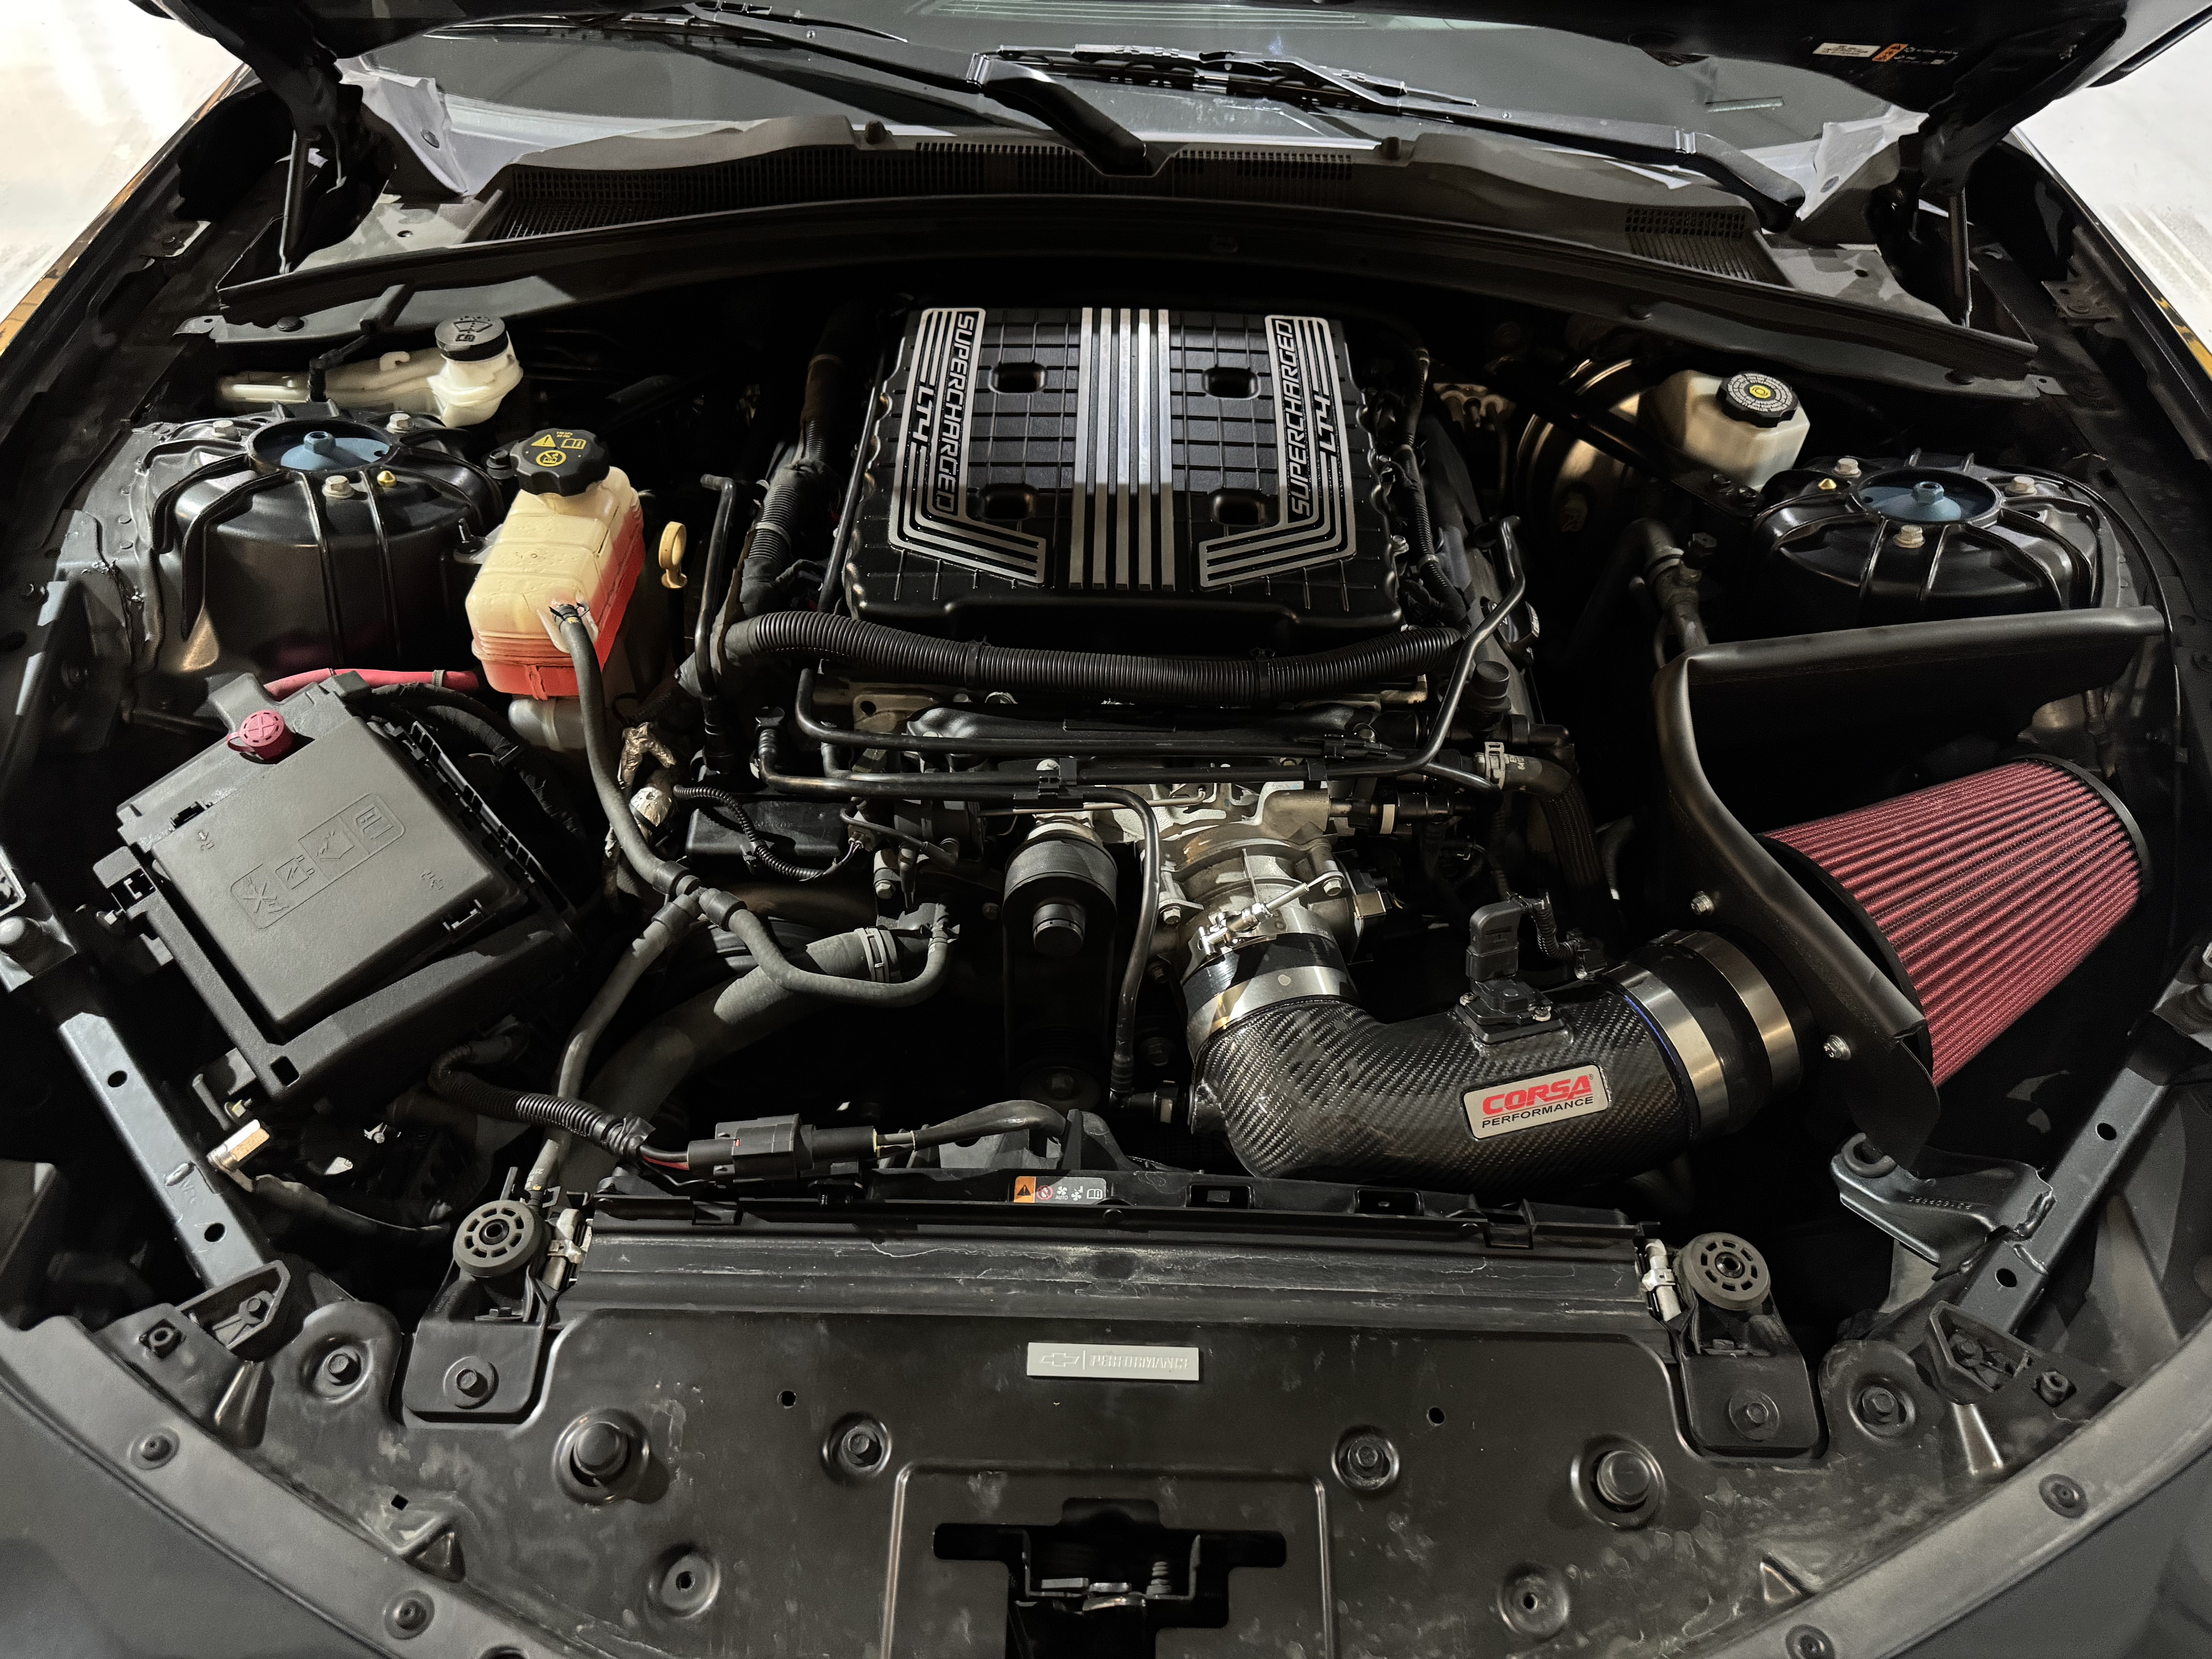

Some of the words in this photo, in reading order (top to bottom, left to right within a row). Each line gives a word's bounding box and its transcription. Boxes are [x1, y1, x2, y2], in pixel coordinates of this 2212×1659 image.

[913, 385, 934, 442] LT4
[936, 313, 974, 512] SUPERCHARGED
[1275, 320, 1310, 517] SUPERCHARGED
[1314, 394, 1336, 452] LT4
[1482, 1075, 1592, 1115] CORSA
[1482, 1096, 1594, 1128] PERFORMANCE
[1089, 1354, 1190, 1369] PERFORMANCE
